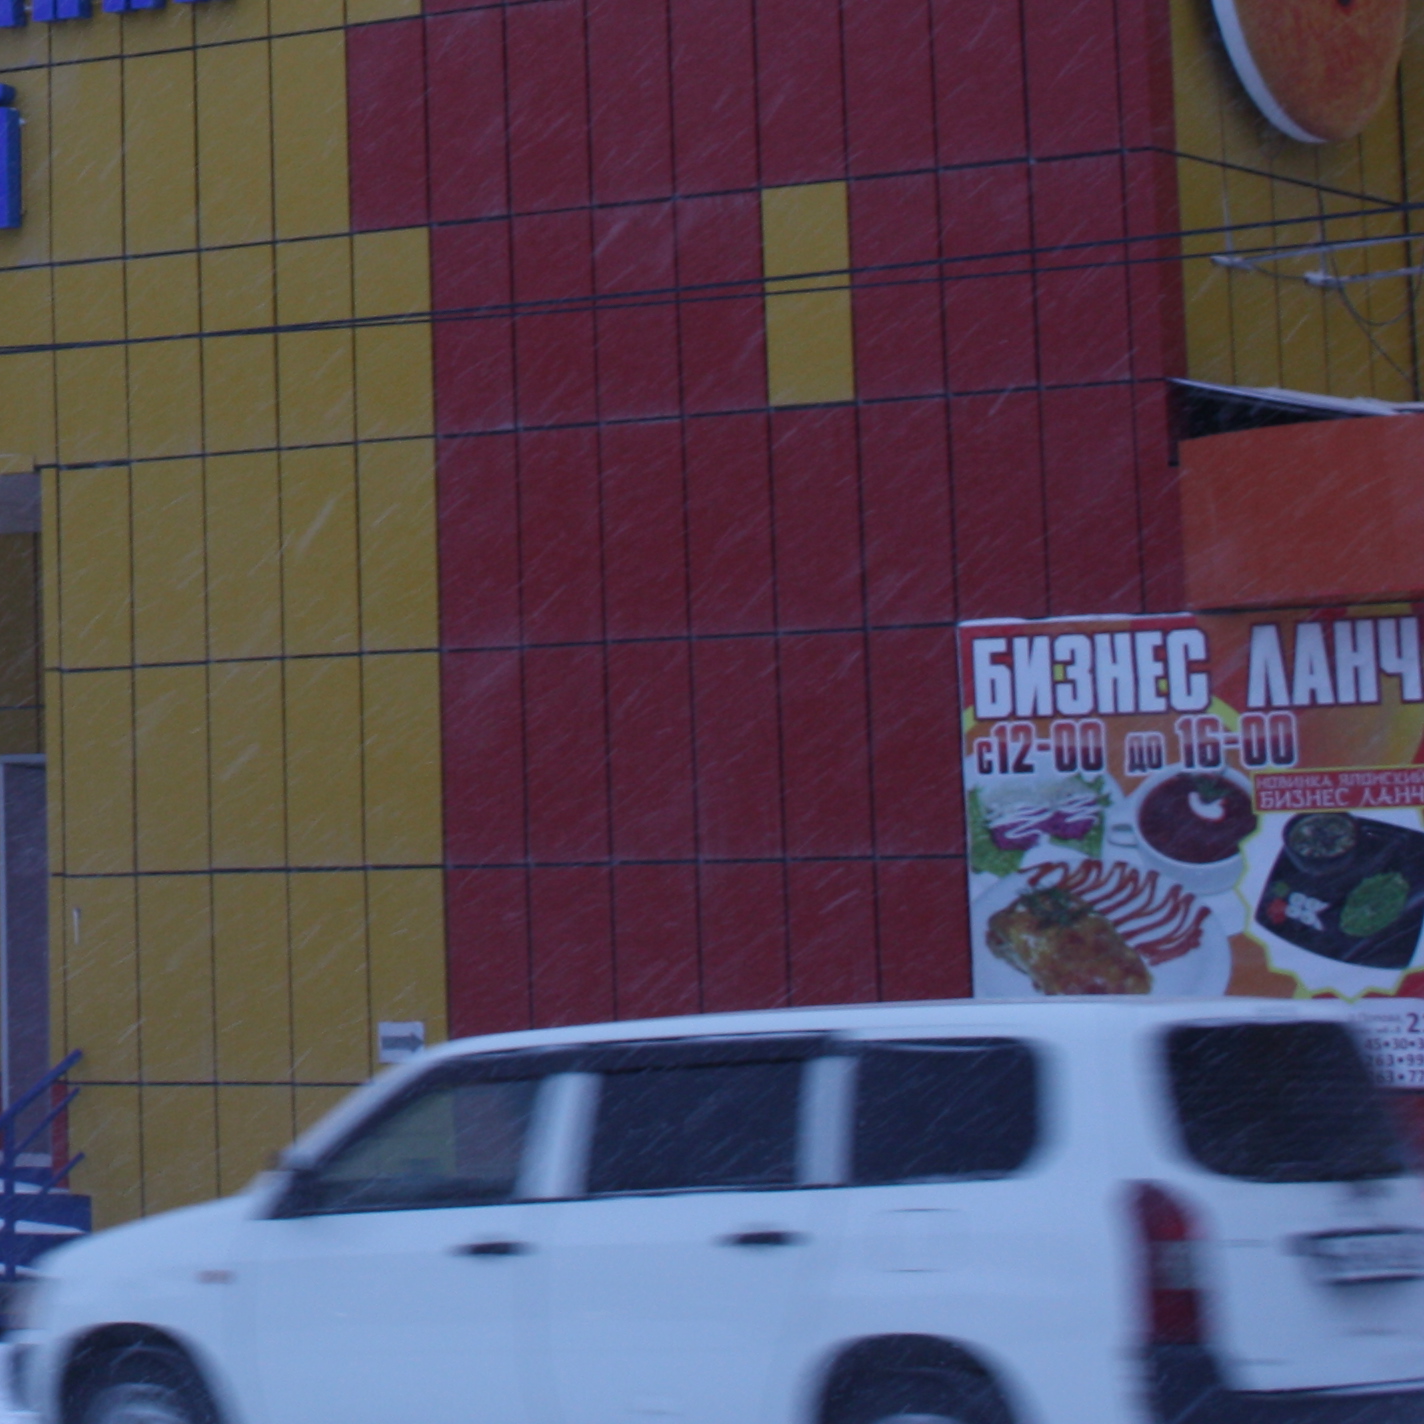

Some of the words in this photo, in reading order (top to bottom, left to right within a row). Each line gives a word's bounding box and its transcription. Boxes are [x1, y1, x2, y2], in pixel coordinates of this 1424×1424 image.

[970, 626, 1211, 719] БИЗНЕС
[1247, 615, 1420, 710] ЛАНЧ
[1175, 712, 1298, 771] 16-00
[1259, 787, 1349, 809] БИЗНЕС
[1358, 784, 1424, 807] ЛАНЧ
